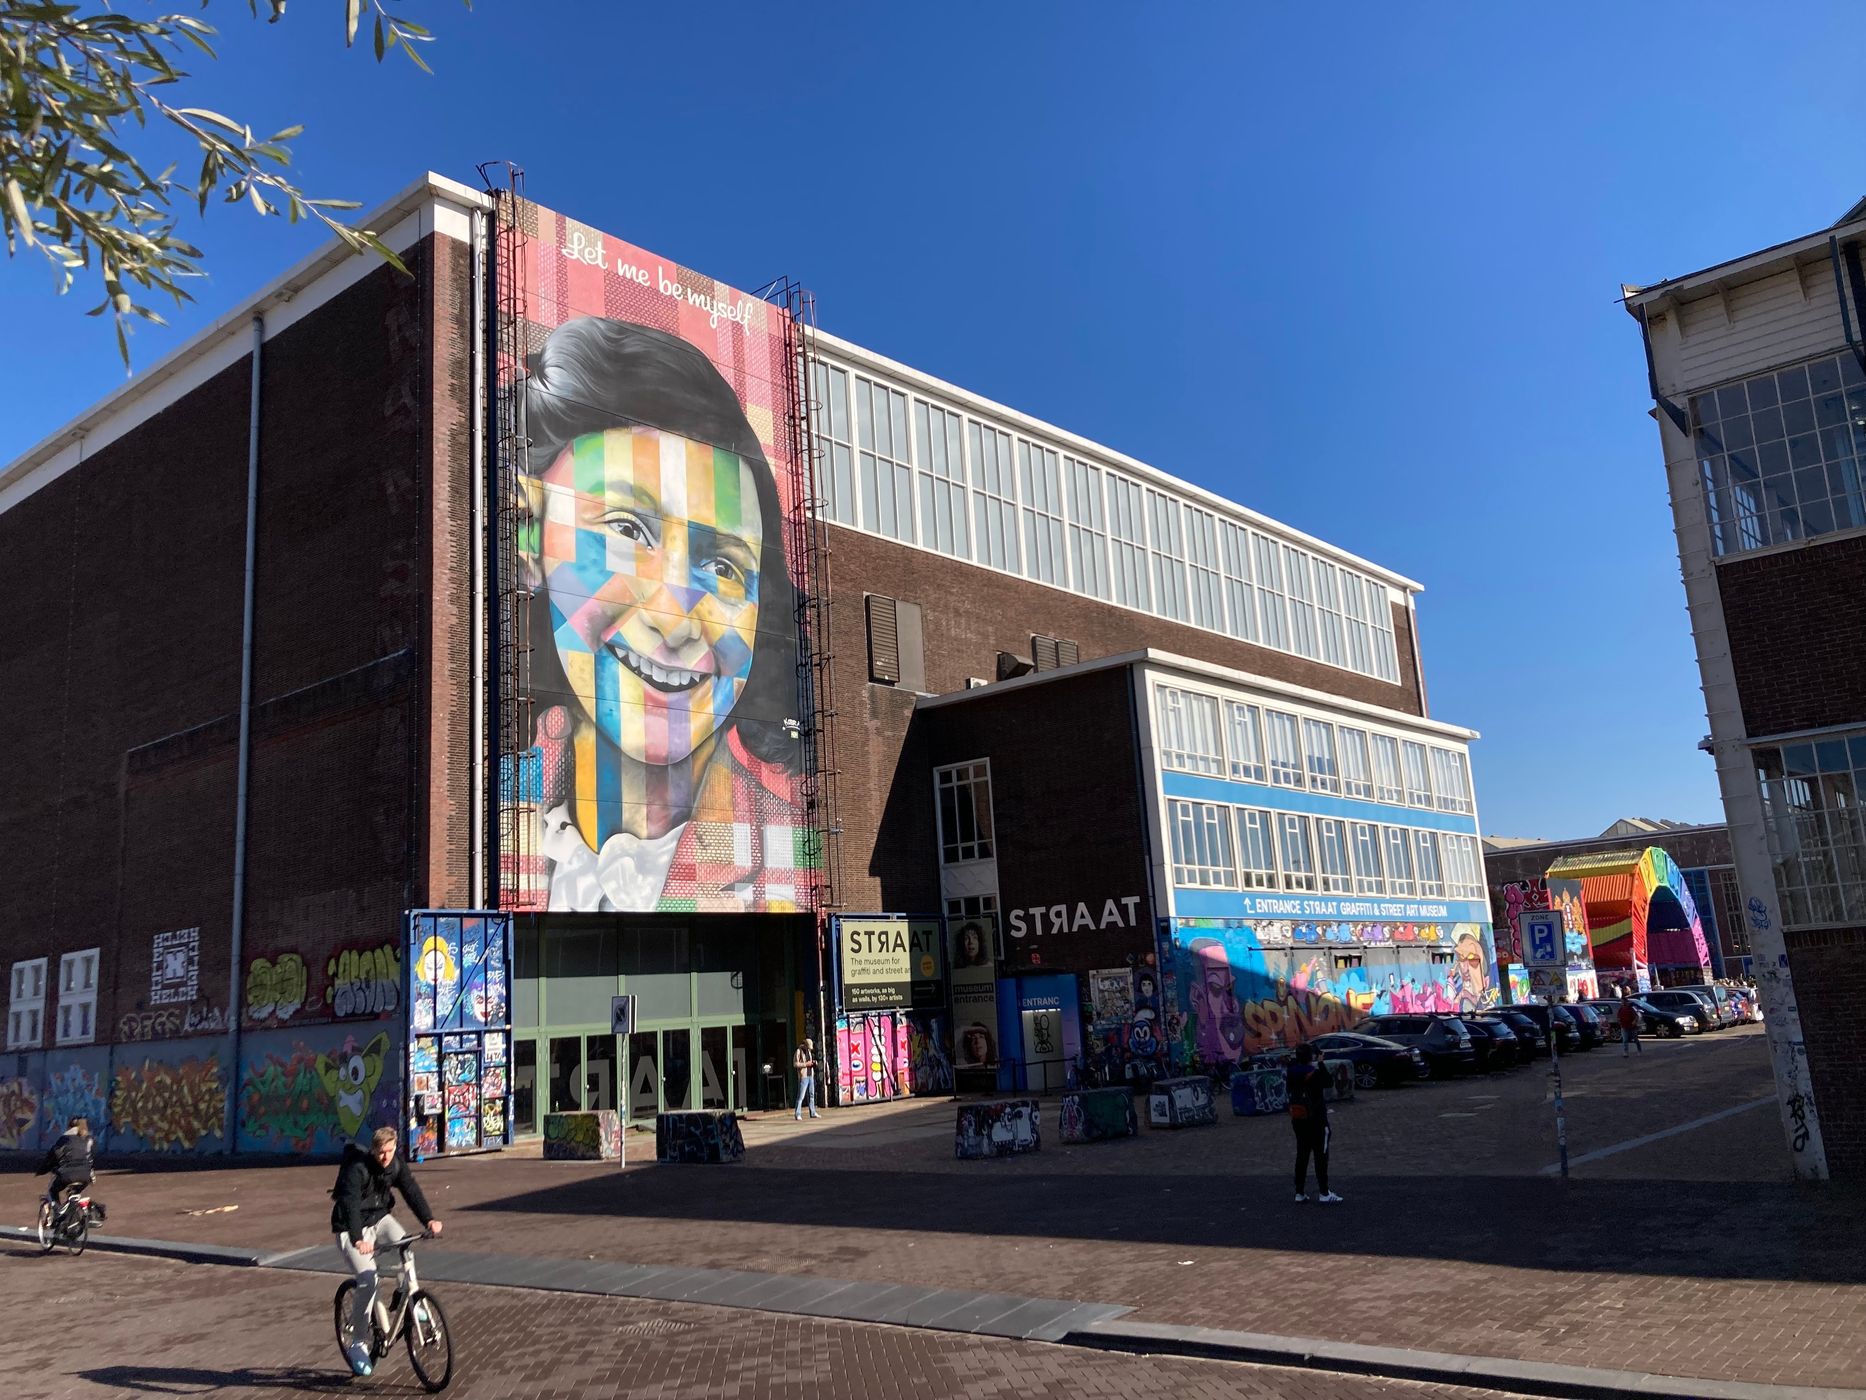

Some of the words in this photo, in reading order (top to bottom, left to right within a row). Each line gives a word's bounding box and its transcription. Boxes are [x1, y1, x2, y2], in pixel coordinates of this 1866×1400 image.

[561, 232, 608, 270] Let
[617, 258, 651, 287] me
[658, 265, 684, 300] be
[687, 288, 754, 335] myself
[1256, 898, 1301, 913] ENTRANCE
[1340, 903, 1373, 915] GRAFFITI
[1374, 904, 1380, 915] &
[1380, 904, 1405, 916] STREET
[1406, 905, 1420, 916] ART
[1420, 905, 1448, 917] MUSEUM
[1534, 925, 1548, 945] P
[850, 957, 862, 966] The
[864, 958, 891, 966] museum
[892, 956, 900, 965] for
[872, 967, 884, 975] and
[886, 967, 903, 975] street
[954, 984, 992, 993] museum
[954, 994, 995, 1003] entrance
